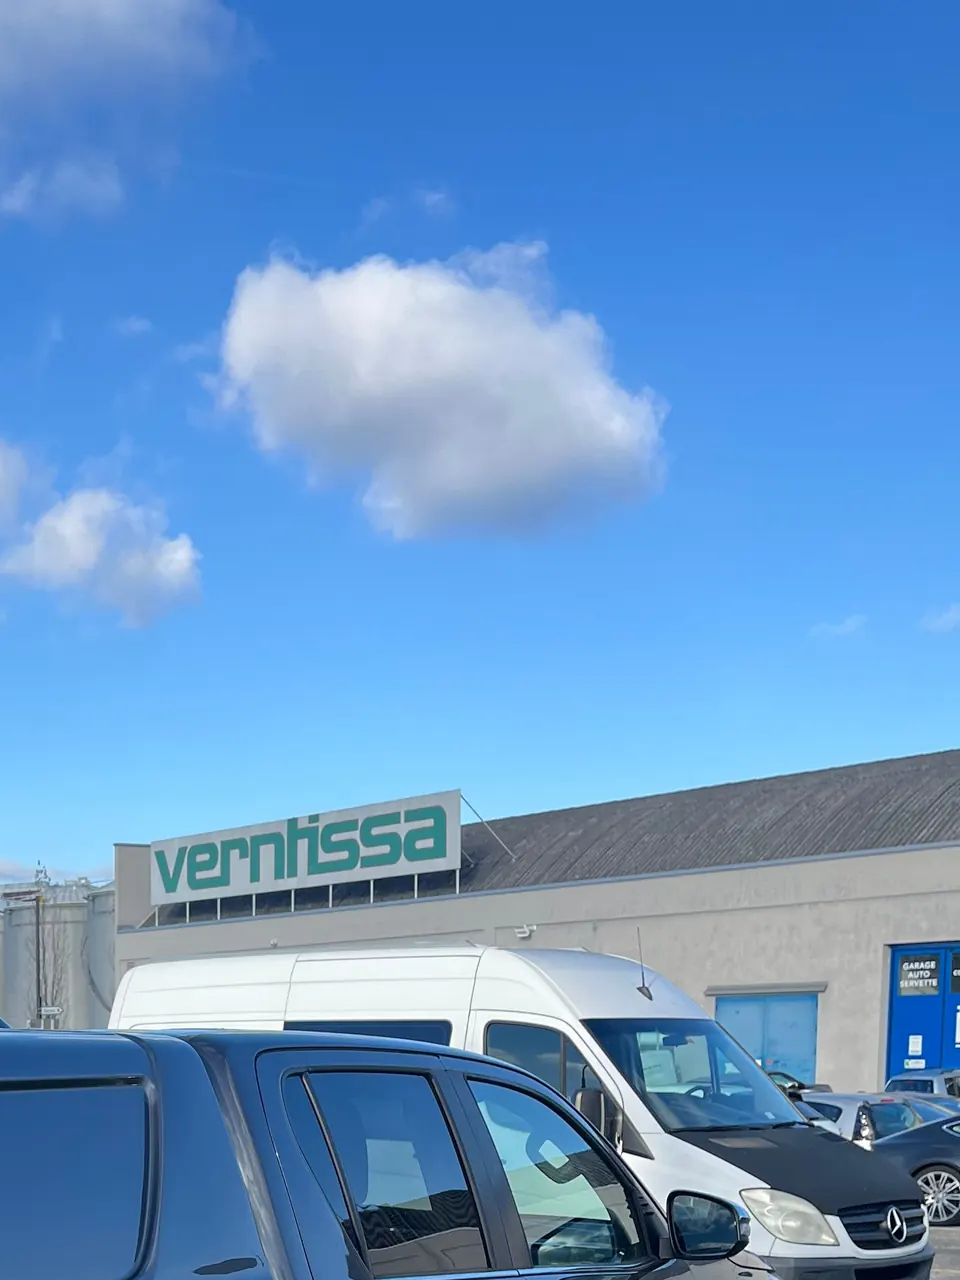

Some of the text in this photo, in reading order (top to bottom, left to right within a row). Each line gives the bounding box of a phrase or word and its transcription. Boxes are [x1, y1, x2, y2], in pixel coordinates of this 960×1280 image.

[902, 961, 936, 970] GARAGE
[908, 970, 931, 978] AUTO
[900, 979, 938, 988] SERVETTE
